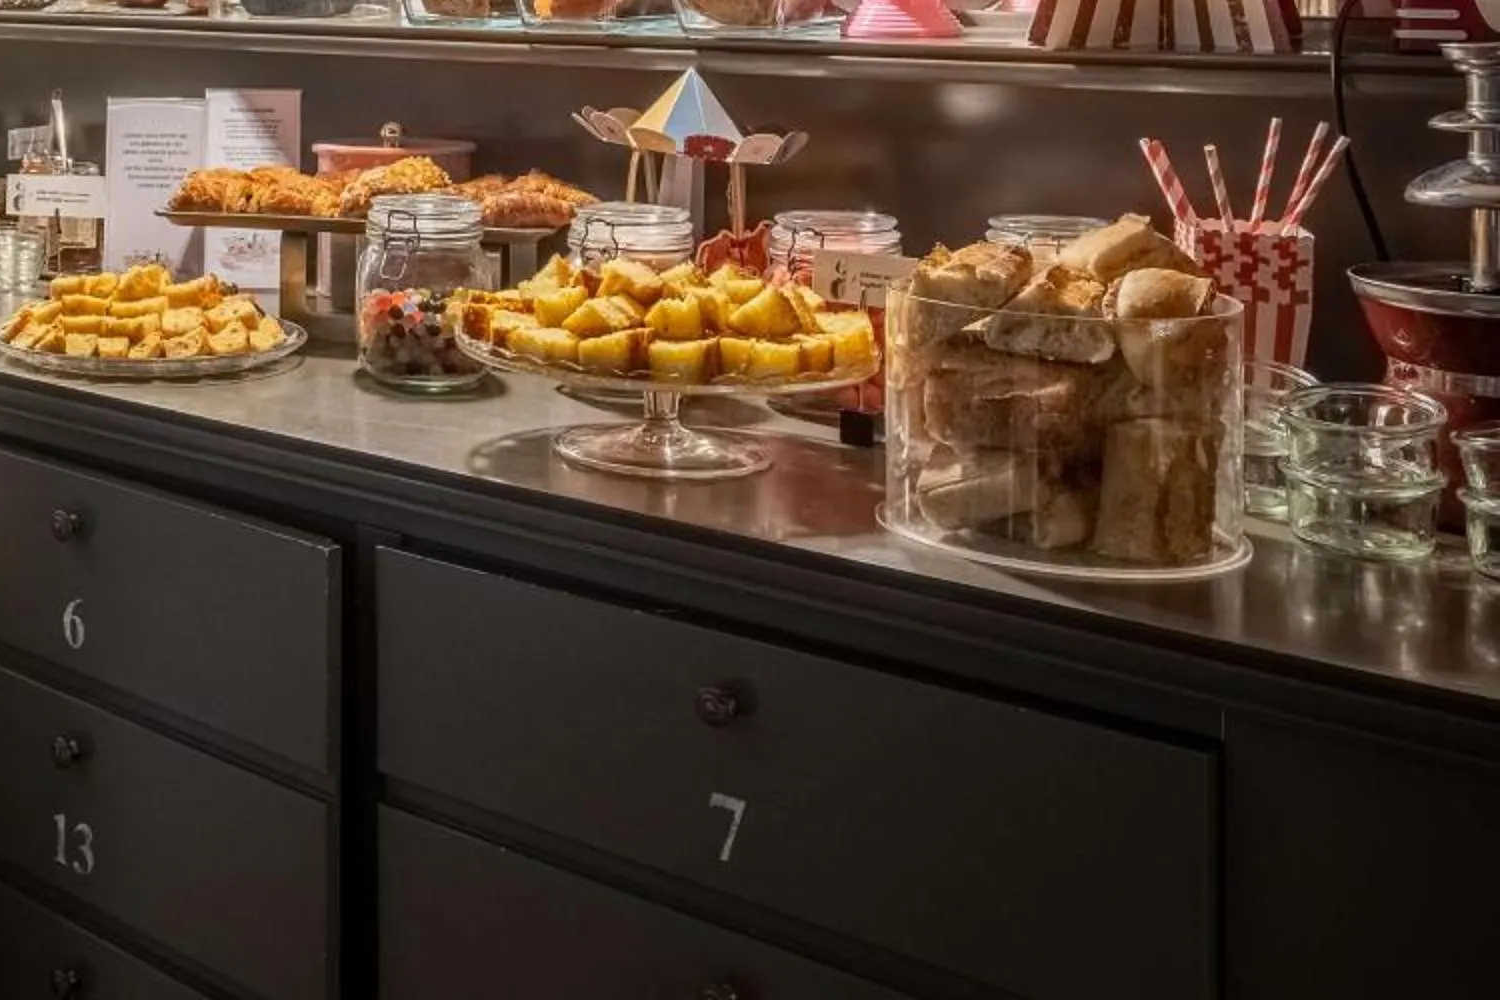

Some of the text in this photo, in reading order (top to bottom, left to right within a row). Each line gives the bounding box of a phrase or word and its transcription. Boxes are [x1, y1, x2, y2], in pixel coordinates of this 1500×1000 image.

[62, 598, 86, 650] 6
[51, 812, 95, 875] 13
[708, 792, 747, 863] 7
